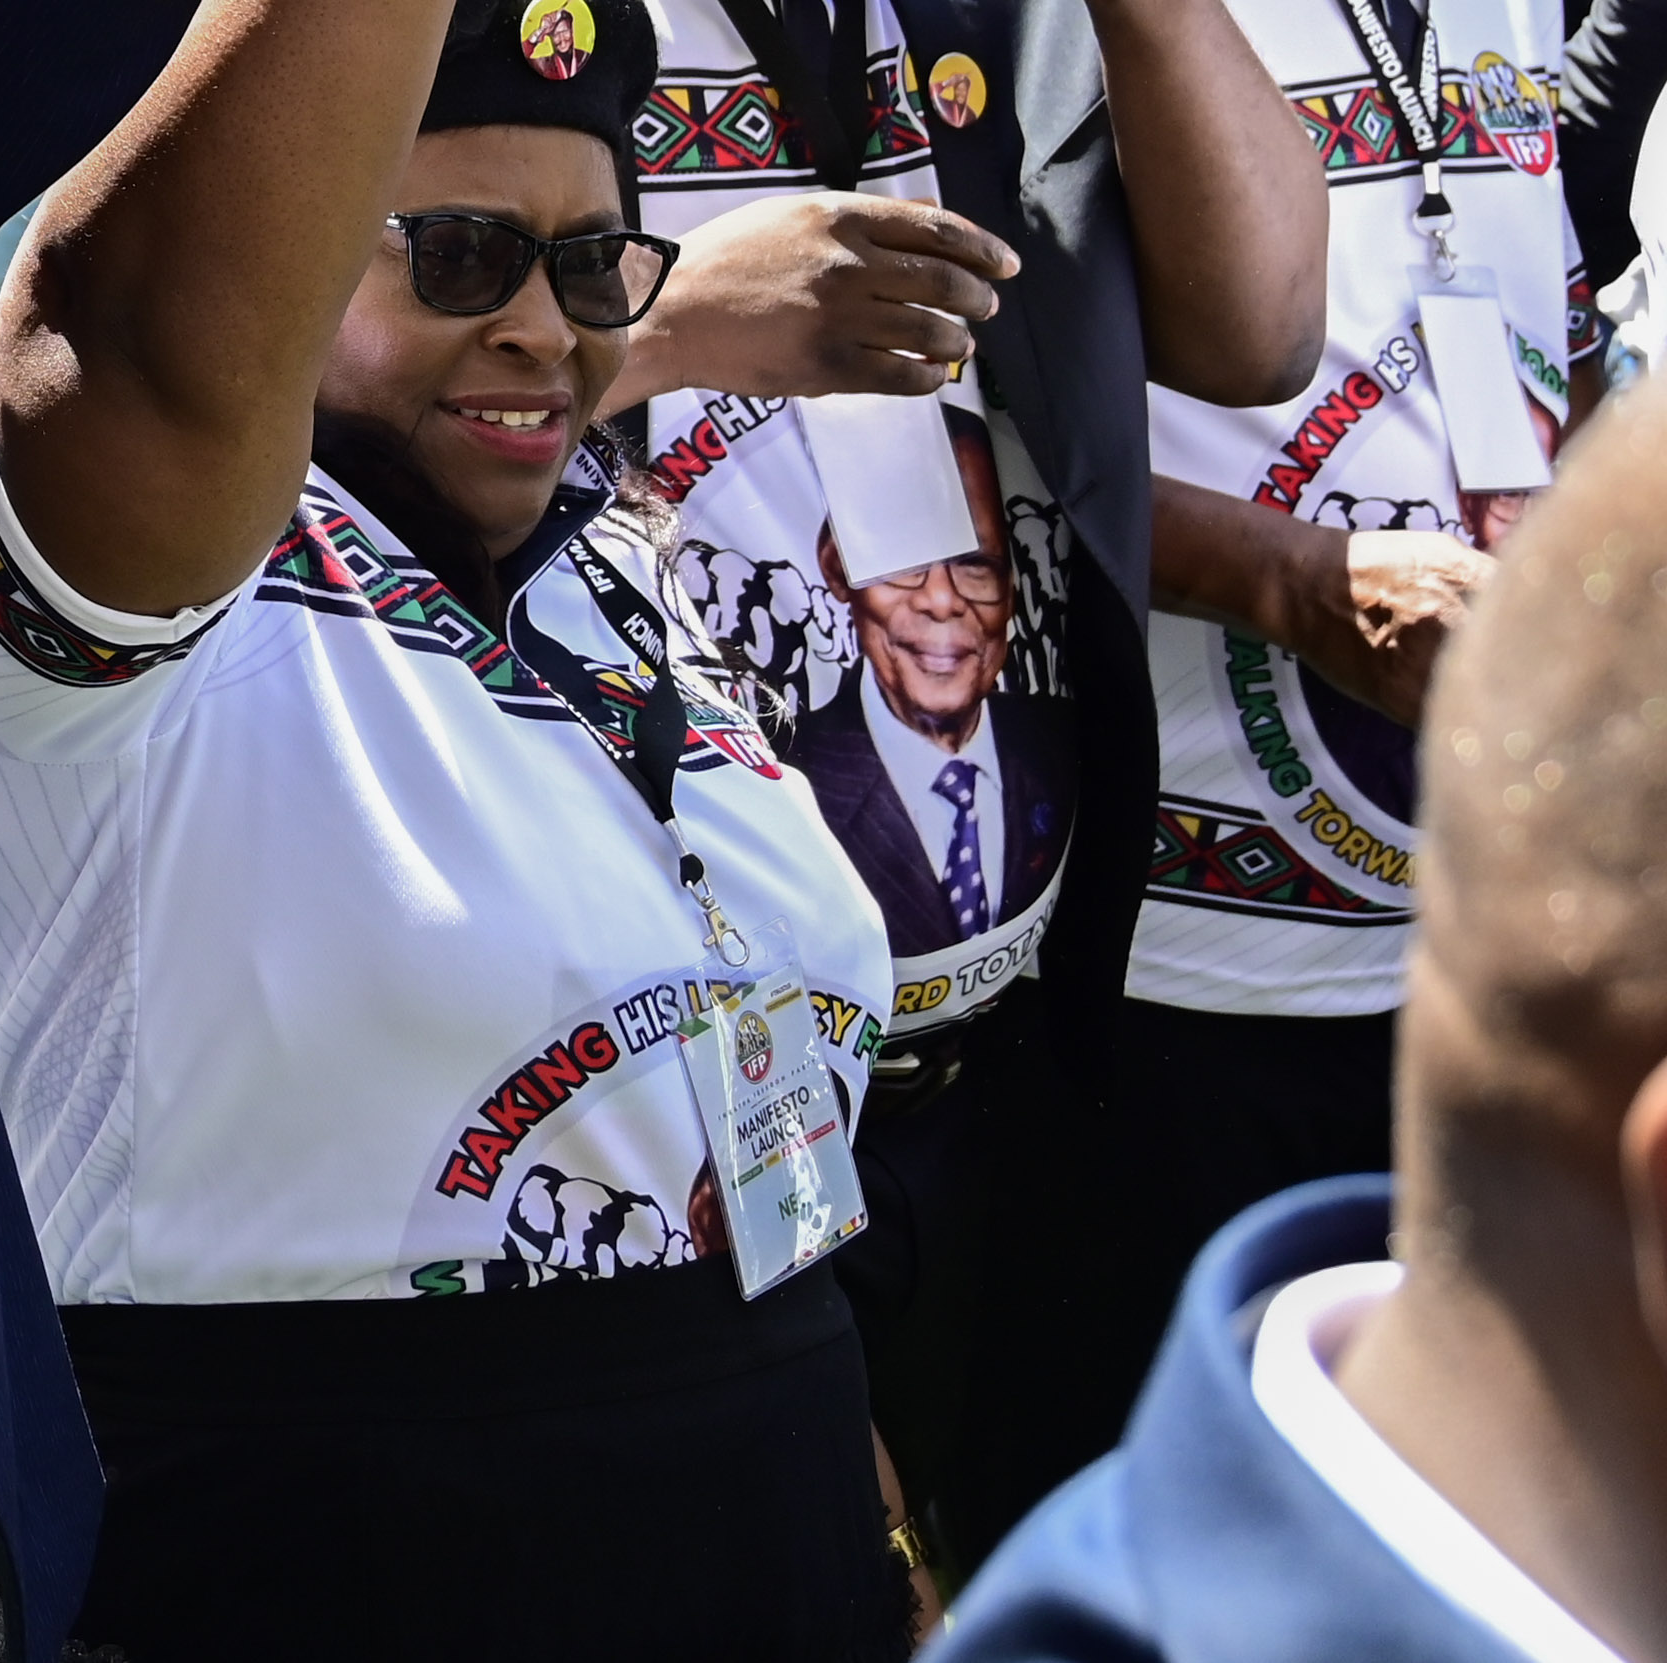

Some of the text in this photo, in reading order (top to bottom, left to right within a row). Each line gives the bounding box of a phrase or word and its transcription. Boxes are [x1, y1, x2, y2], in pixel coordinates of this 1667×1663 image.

[1390, 74, 1437, 152] LAUNCH
[1503, 136, 1546, 167] IFP
[584, 563, 617, 594] IFP
[747, 1053, 767, 1079] IFP
[435, 1021, 620, 1203] TAKING
[613, 983, 685, 1056] HIS
[736, 1086, 810, 1145] MANIFESTO
[751, 1112, 806, 1160] LAUNCH
